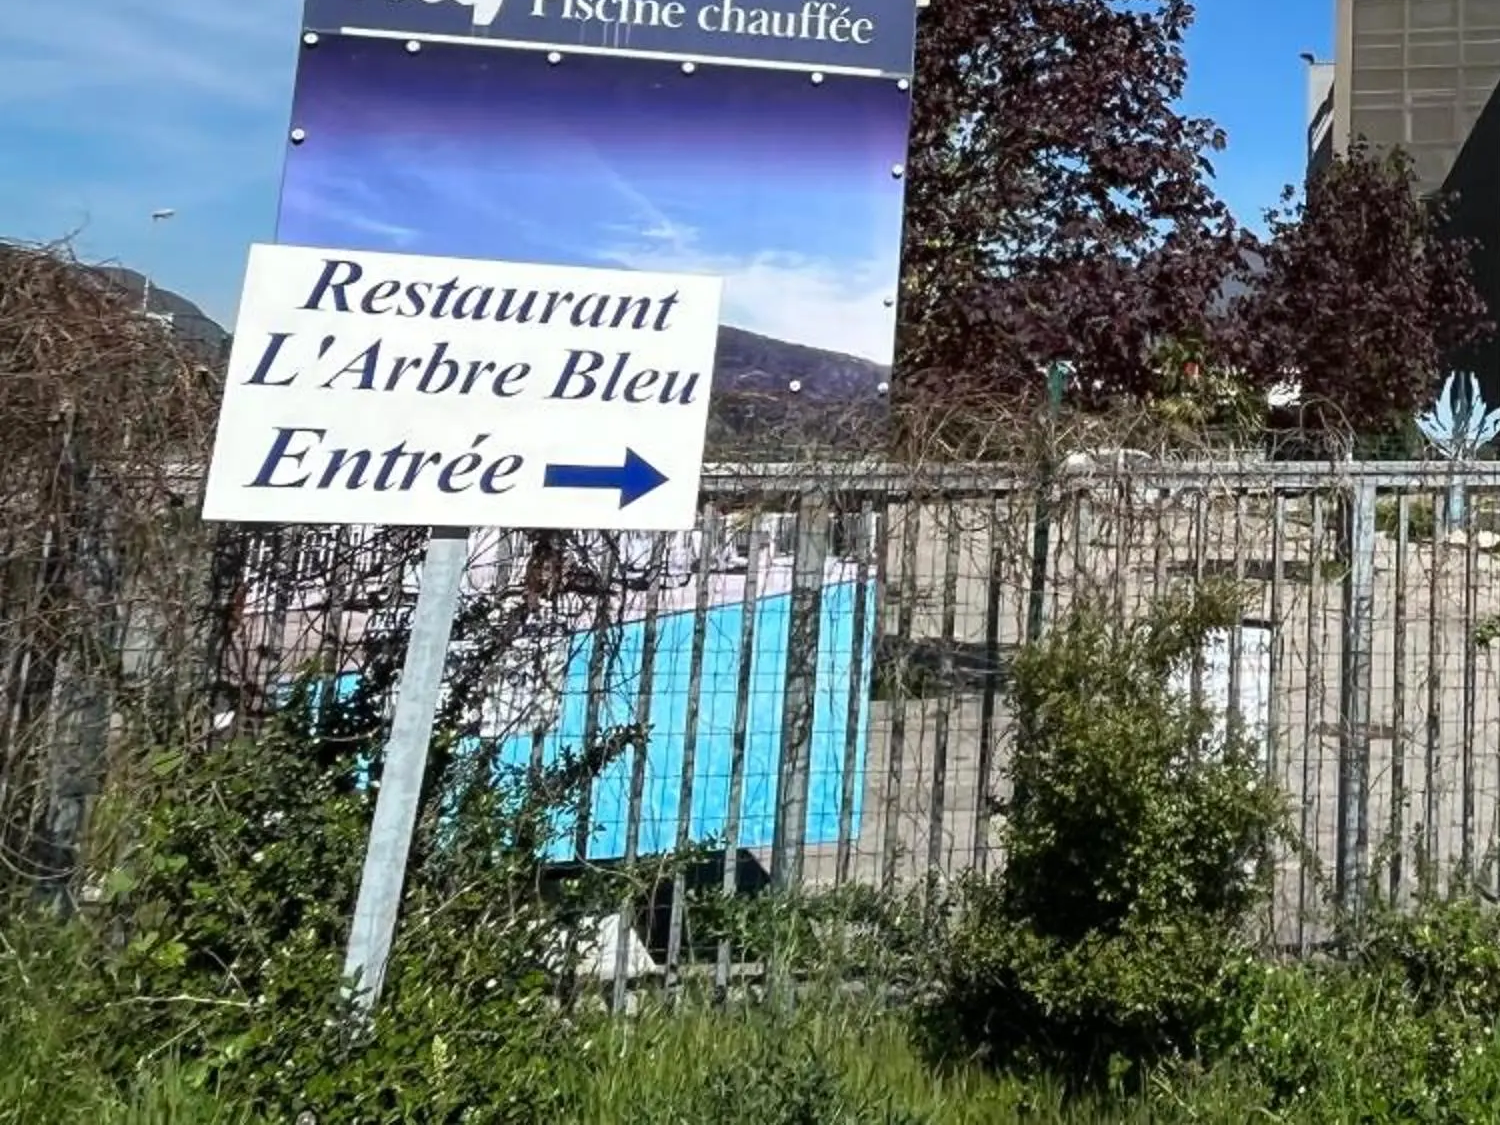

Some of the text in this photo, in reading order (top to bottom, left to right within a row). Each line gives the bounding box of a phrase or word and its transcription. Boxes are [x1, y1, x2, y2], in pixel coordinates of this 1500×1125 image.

[297, 259, 680, 332] Restaurant
[241, 332, 700, 406] L'Arbre Bleu
[242, 426, 524, 495] Entrée
